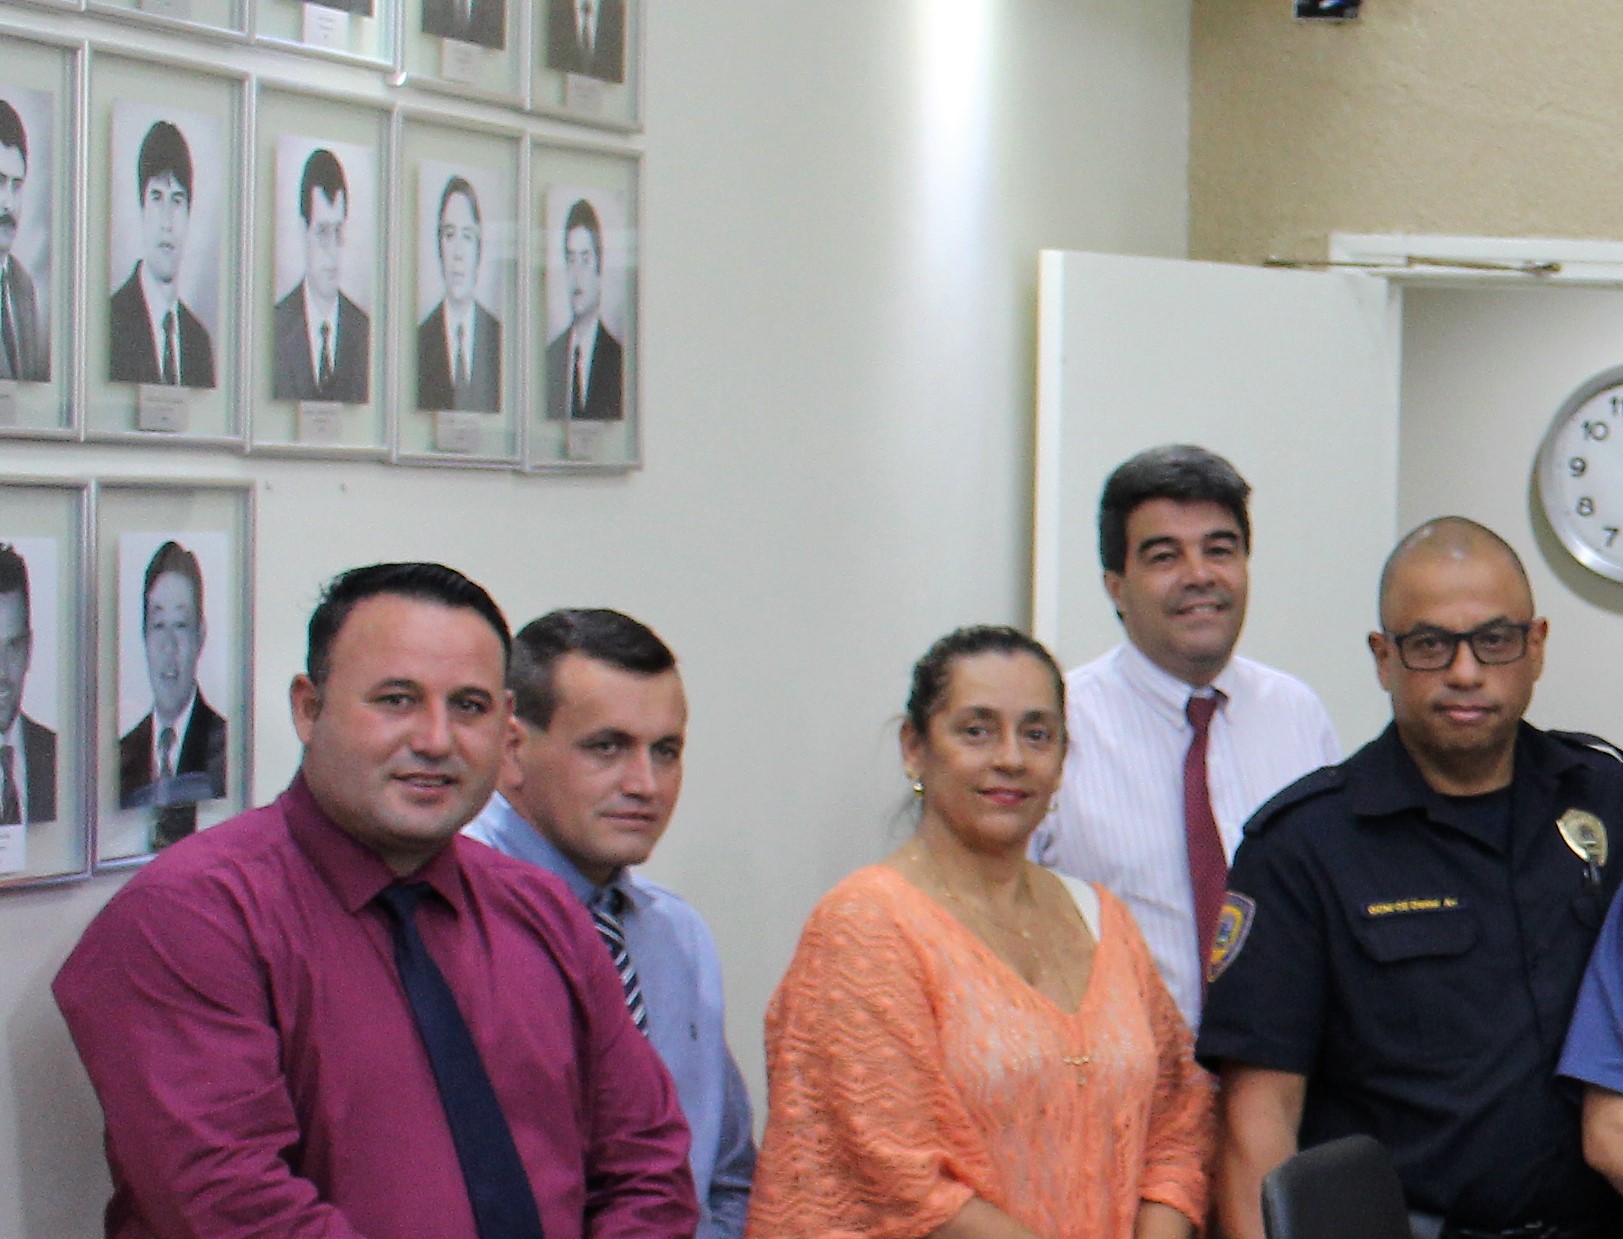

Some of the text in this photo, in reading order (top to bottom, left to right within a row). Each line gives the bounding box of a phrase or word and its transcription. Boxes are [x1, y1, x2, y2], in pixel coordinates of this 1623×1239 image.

[1581, 420, 1609, 441] 10
[1569, 457, 1587, 478] 9
[1576, 497, 1595, 517] 8
[1602, 527, 1620, 547] 7
